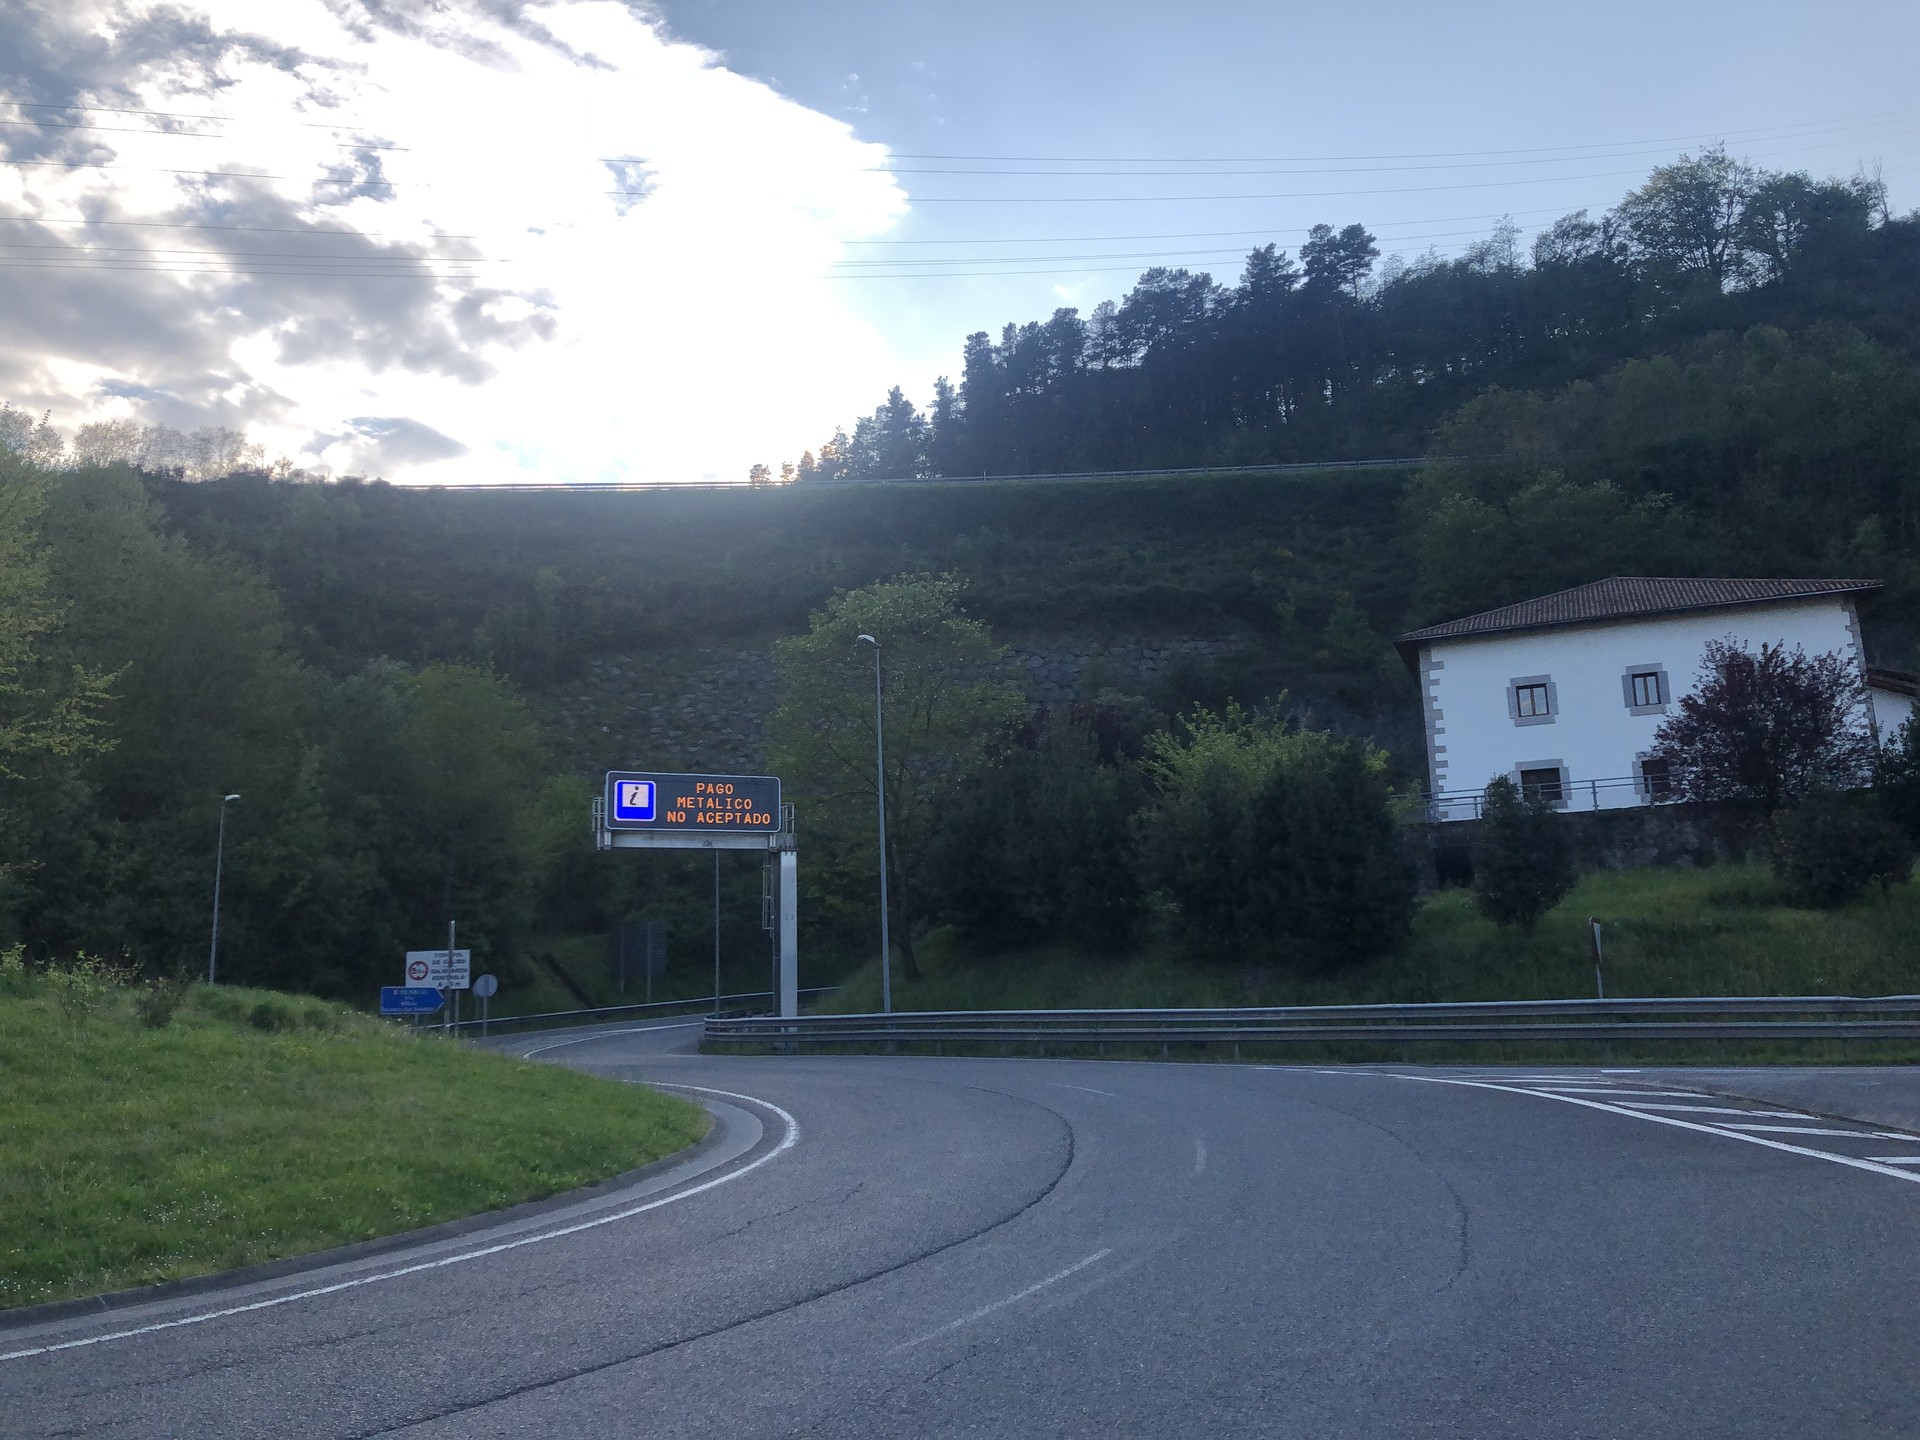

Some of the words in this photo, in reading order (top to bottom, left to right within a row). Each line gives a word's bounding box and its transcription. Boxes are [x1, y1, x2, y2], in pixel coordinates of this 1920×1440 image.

[696, 782, 734, 795] PAGO
[676, 796, 753, 810] METALICO
[666, 810, 686, 823] NO
[696, 811, 771, 825] ACEPTADO
